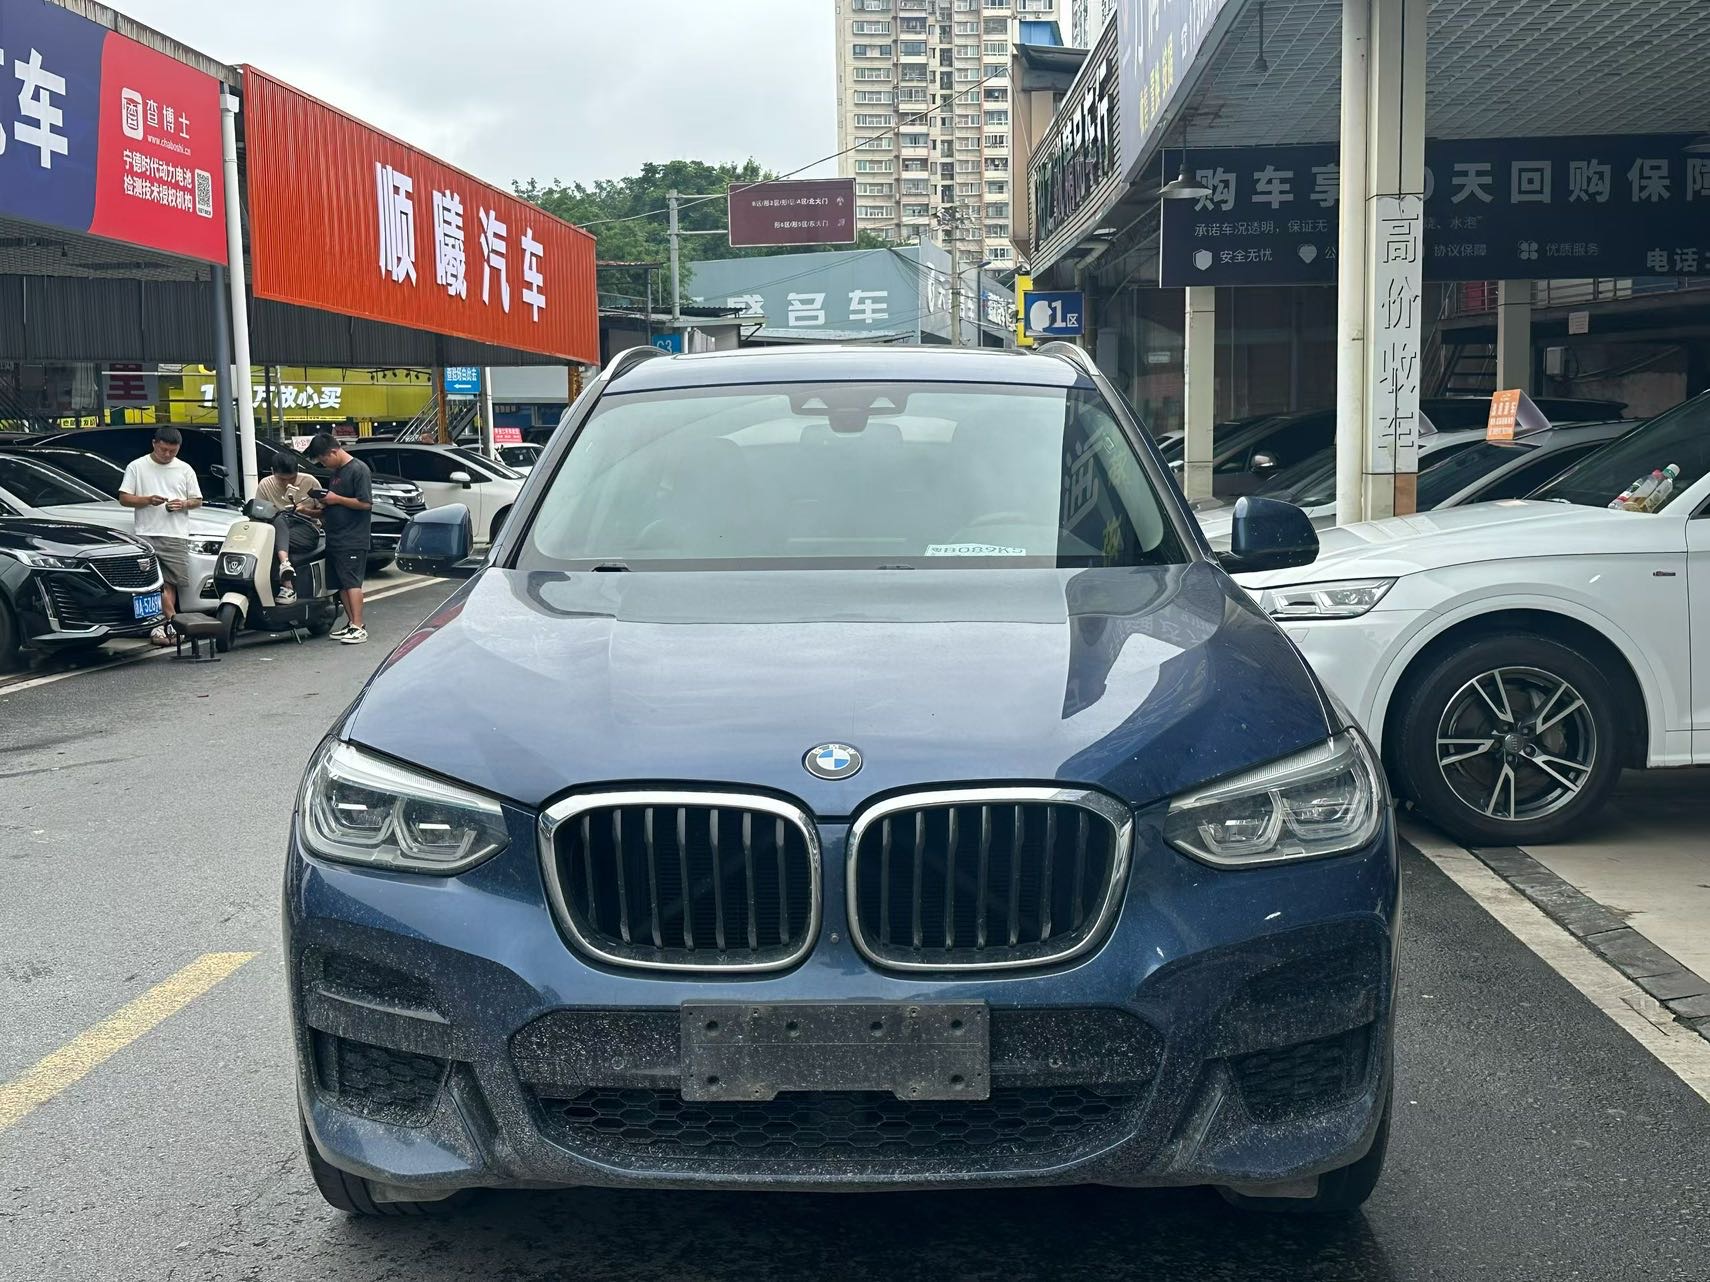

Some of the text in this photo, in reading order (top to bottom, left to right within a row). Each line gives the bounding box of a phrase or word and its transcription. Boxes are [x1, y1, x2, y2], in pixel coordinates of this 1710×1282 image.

[0, 47, 69, 170] 车
[146, 99, 190, 139] 查博士
[123, 148, 192, 189] 宁德时代动力电池
[124, 173, 193, 212] 检测技术授权机构
[375, 161, 546, 323] 顺曦汽车
[1220, 248, 1273, 264] 安全无忧
[1434, 243, 1487, 257] 协议保障
[1546, 241, 1600, 257] 优质服务
[1378, 207, 1420, 449] 高价收车
